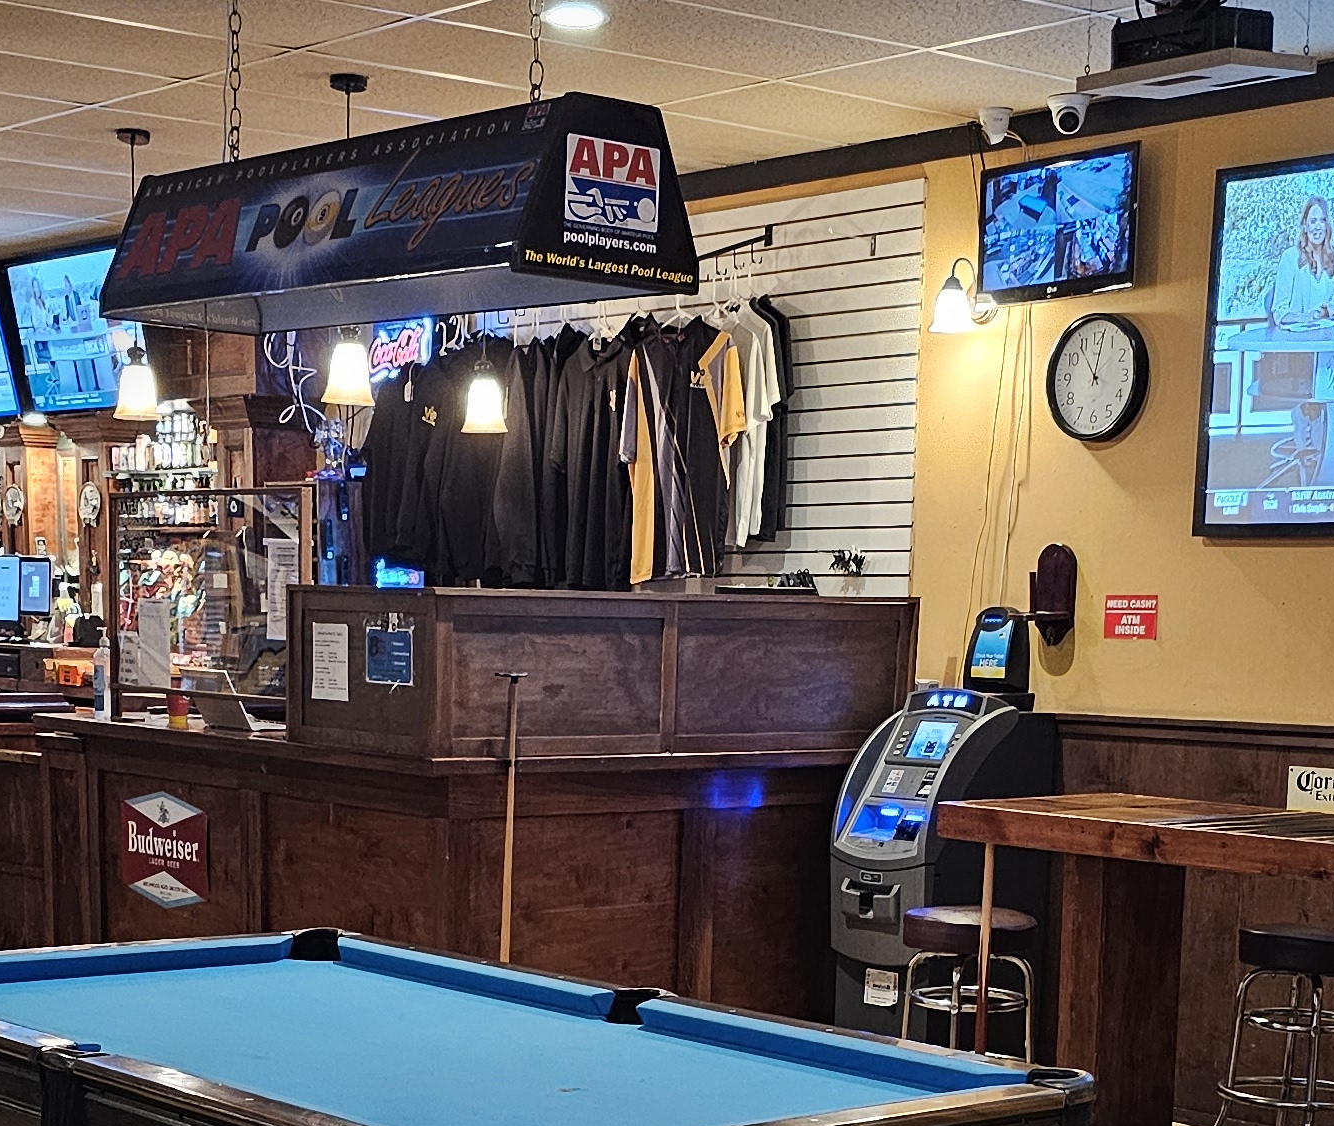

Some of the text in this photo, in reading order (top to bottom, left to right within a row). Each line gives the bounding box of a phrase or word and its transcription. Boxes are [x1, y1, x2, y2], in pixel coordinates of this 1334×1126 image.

[145, 120, 513, 198] AMERICAN POOLPLAYERS ASSOCIATION
[569, 137, 657, 187] APA
[117, 147, 536, 280] APA POOL Leagues
[563, 231, 657, 254] poolplayers.com
[525, 250, 694, 284] The World's Largest Pool League
[1068, 352, 1079, 367] 10
[1118, 348, 1127, 362] 2
[1063, 373, 1072, 387] 9
[1121, 368, 1129, 382] 3
[1066, 391, 1075, 405] 8
[1115, 388, 1123, 402] 4
[1077, 406, 1084, 420] 7
[1090, 410, 1098, 423] 6
[1105, 404, 1113, 418] 5
[1107, 600, 1157, 608] NEED CASH?
[1121, 615, 1141, 625] ATM
[1115, 625, 1146, 635] INSIDE
[979, 658, 999, 668] HERE
[127, 820, 199, 863] Budweiser
[149, 857, 180, 869] LAGER BEER
